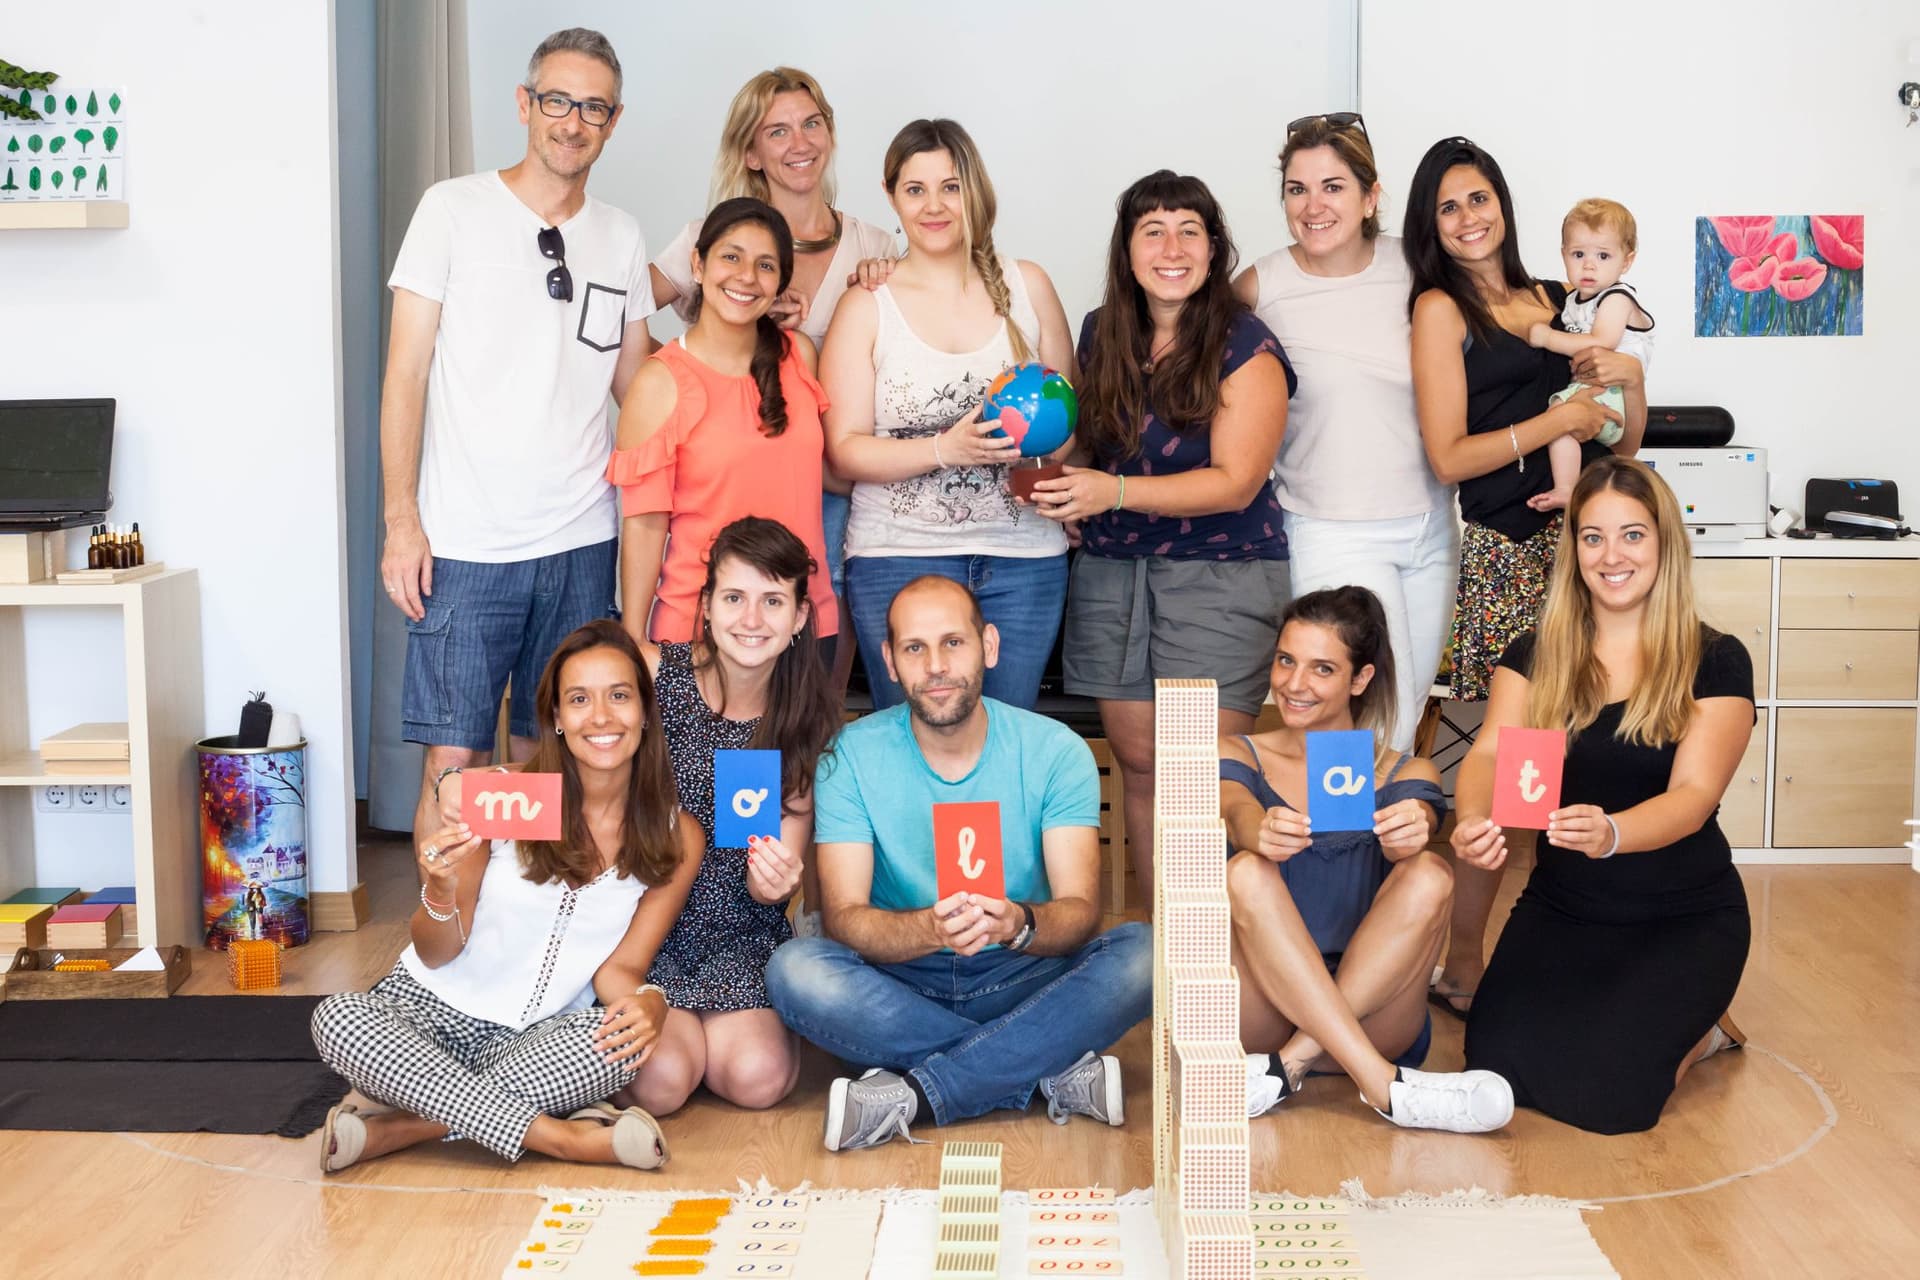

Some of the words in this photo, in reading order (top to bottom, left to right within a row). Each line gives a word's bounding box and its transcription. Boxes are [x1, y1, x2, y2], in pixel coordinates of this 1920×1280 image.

[1322, 766, 1366, 796] a
[1518, 759, 1547, 802] t
[474, 790, 543, 821] m
[731, 787, 768, 818] o
[957, 826, 985, 880] l
